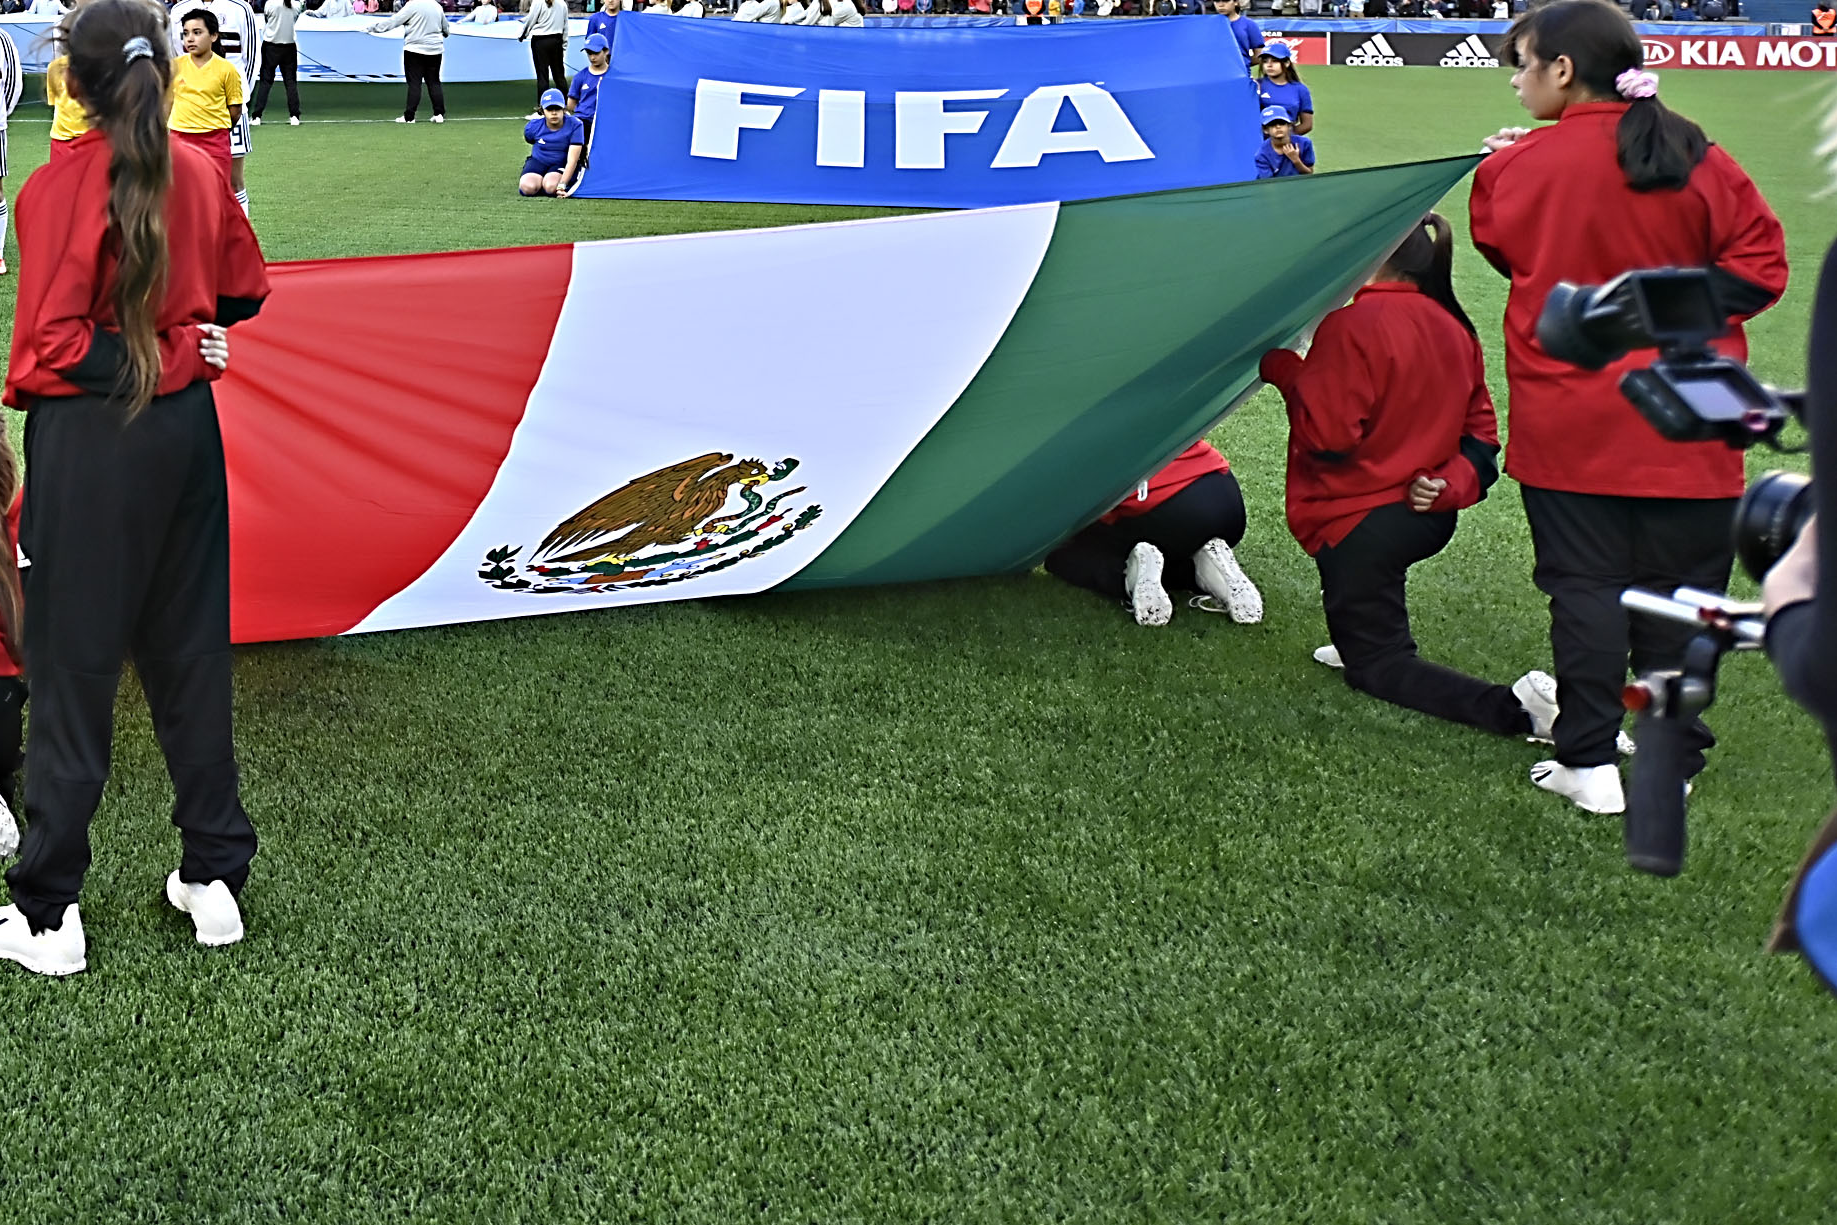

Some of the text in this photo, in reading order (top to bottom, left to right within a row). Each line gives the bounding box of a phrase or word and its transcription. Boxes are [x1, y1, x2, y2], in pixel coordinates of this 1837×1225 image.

[1345, 54, 1404, 67] adidas
[1439, 55, 1500, 68] adidas
[1680, 40, 1746, 66] KIA
[1755, 40, 1837, 68] MOT
[690, 78, 1156, 170] FIFA
